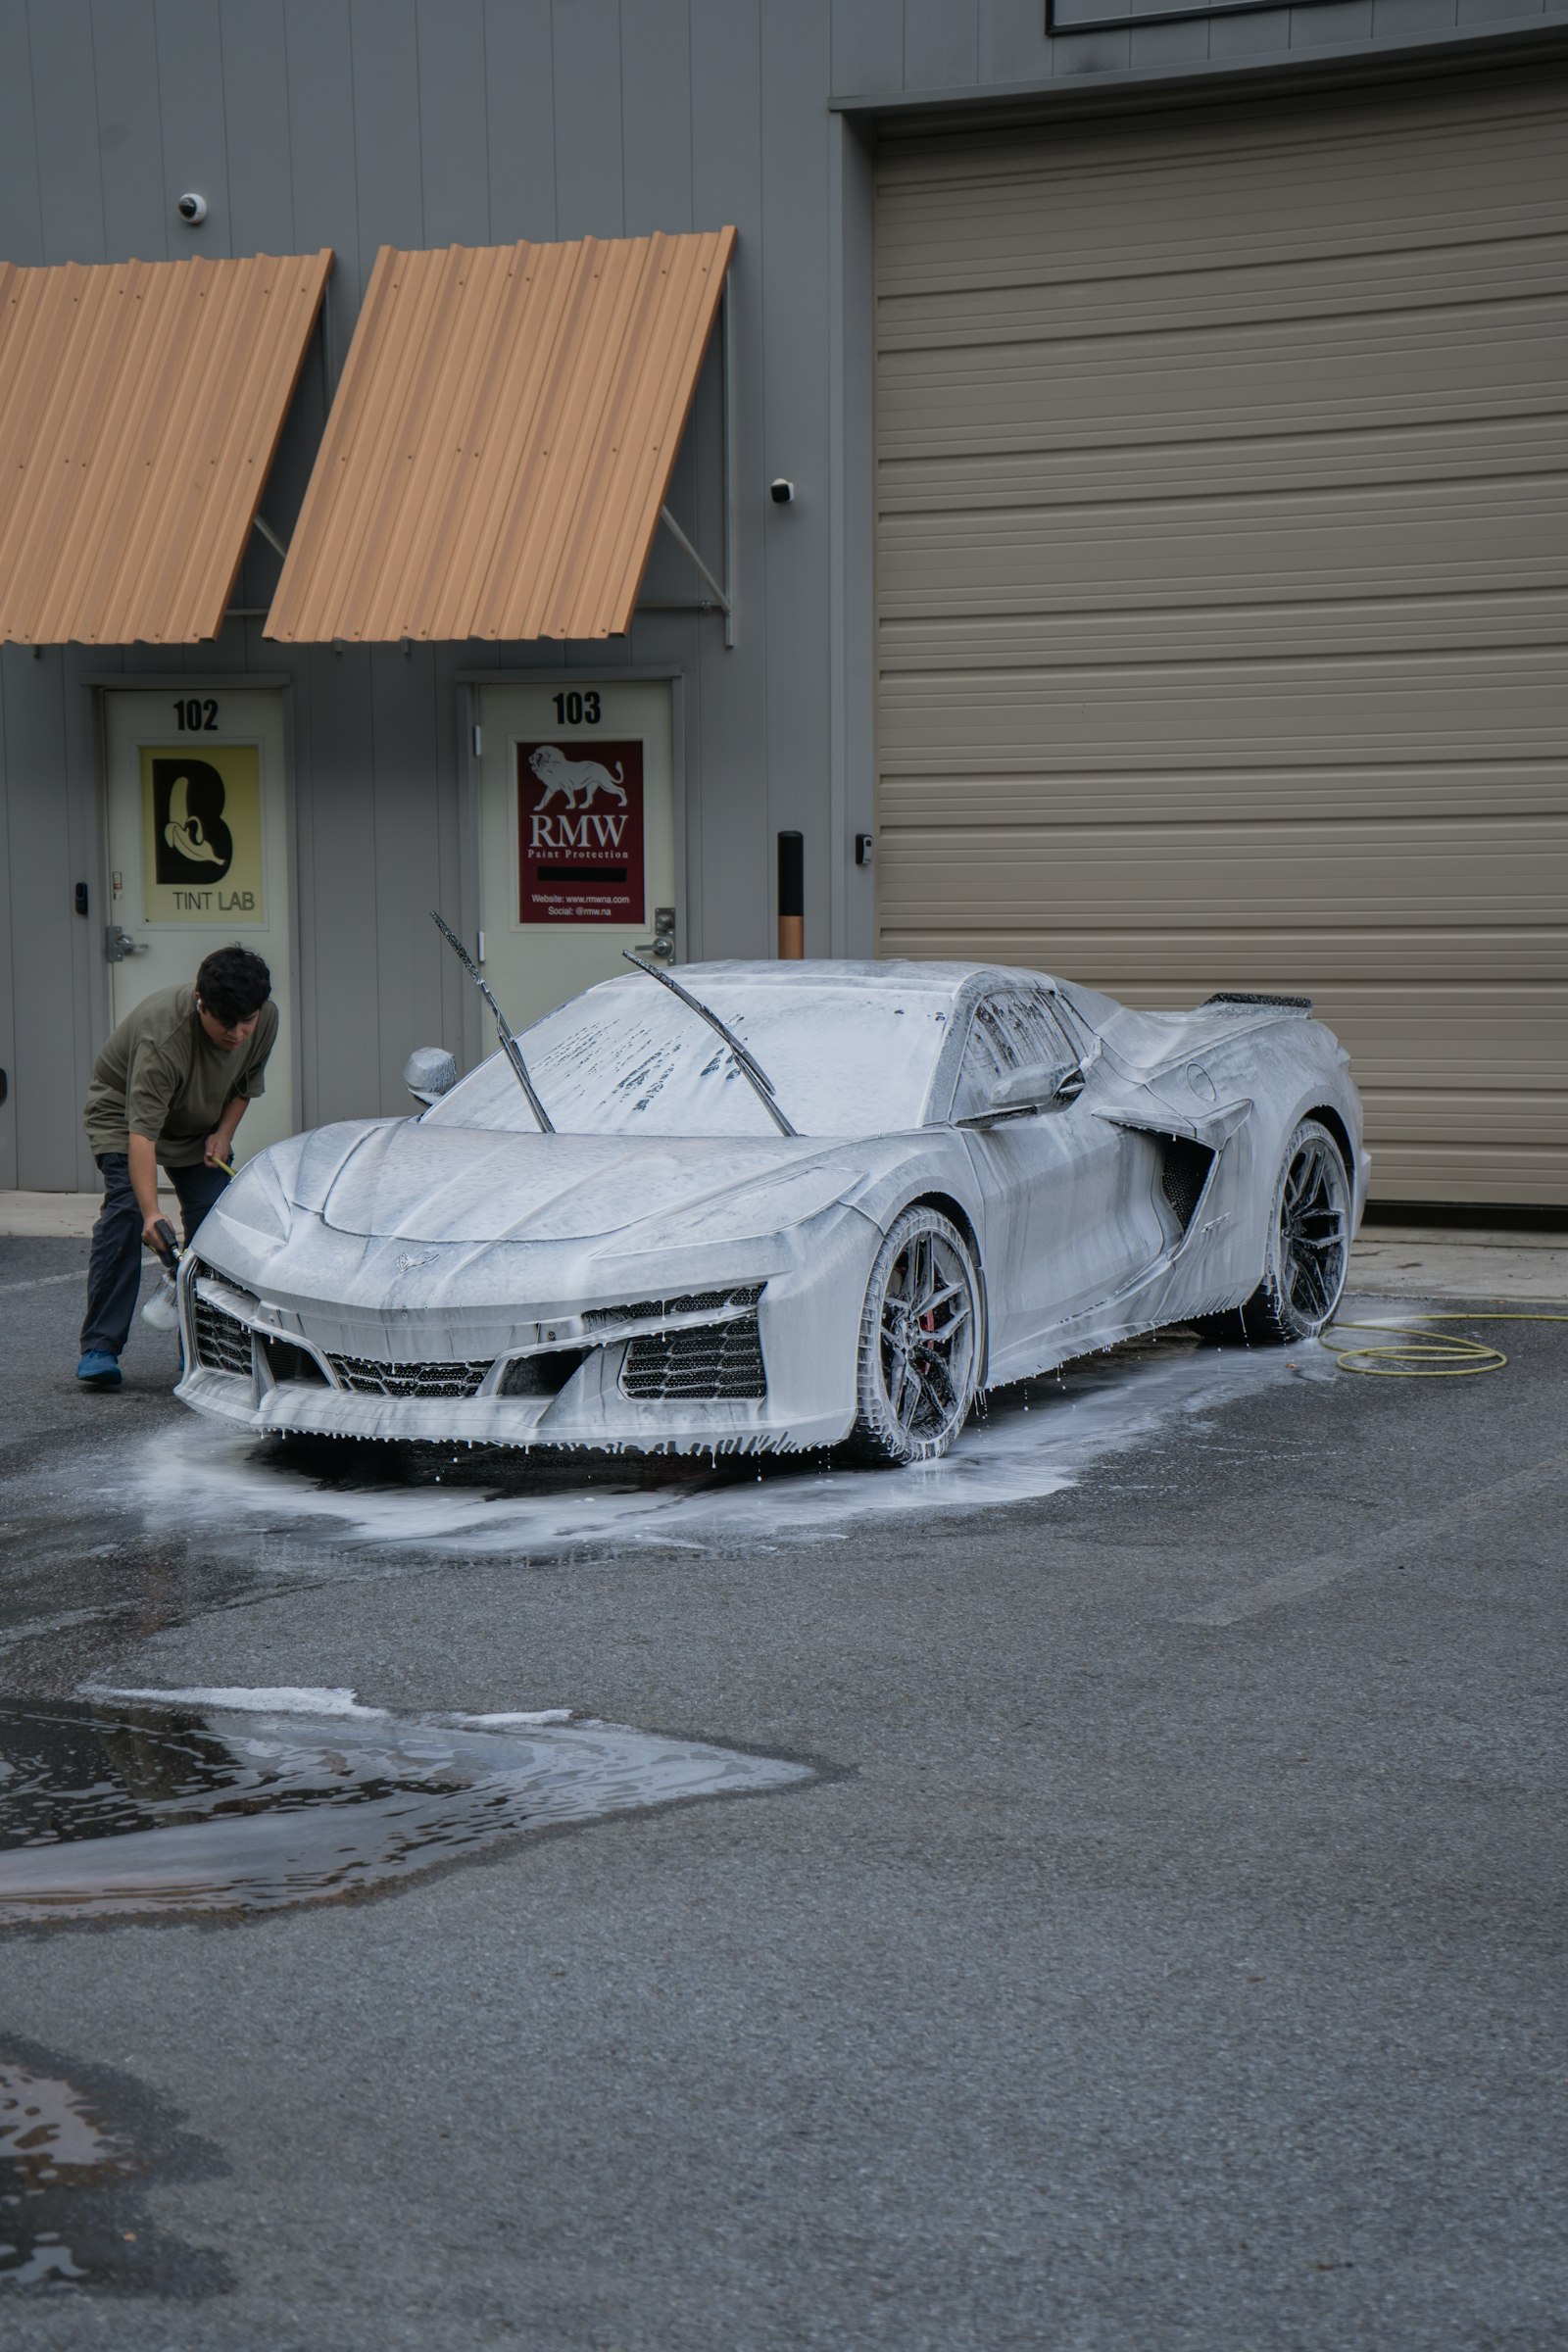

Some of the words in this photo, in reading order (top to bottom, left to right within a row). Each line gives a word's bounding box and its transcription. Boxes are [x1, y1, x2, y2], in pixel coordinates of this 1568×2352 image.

[173, 699, 219, 731] 102
[552, 691, 602, 725] 103
[529, 814, 629, 848] RMW
[527, 849, 560, 858] Paint
[564, 849, 628, 858] Protection
[172, 892, 213, 910] TINT
[219, 892, 255, 910] LAB
[531, 894, 564, 904] Website:
[548, 906, 573, 915] Social:
